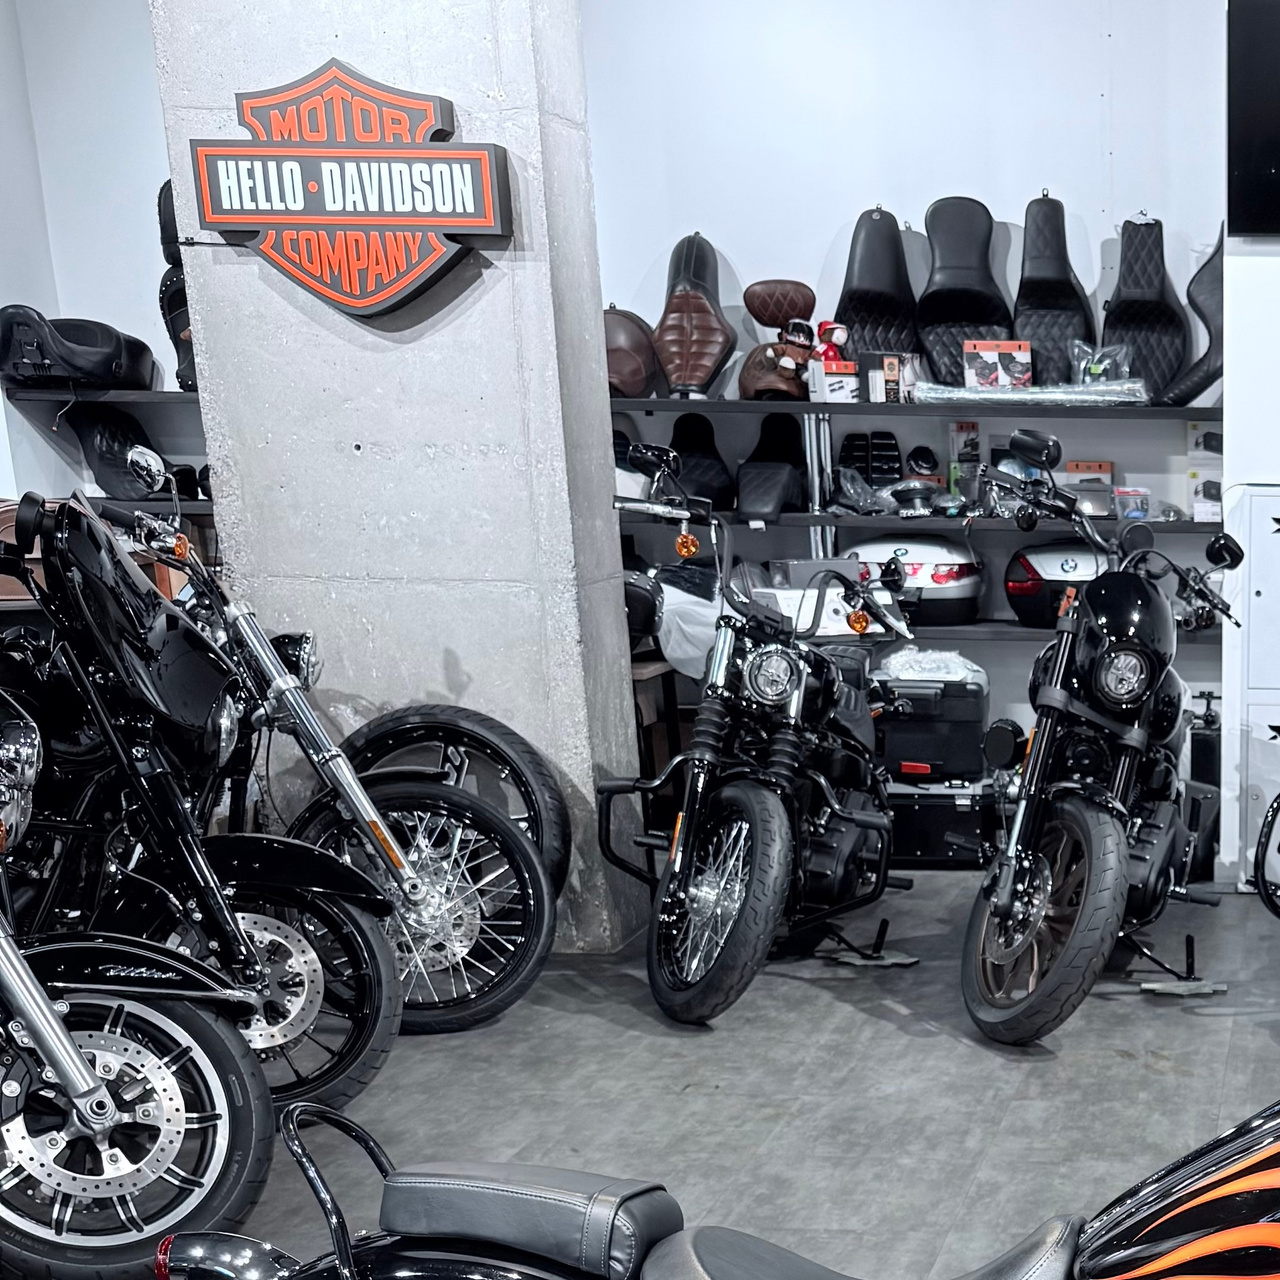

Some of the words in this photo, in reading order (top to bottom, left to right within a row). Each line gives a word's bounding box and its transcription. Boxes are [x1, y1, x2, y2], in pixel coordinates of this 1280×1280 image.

[269, 83, 411, 143] MOTOR
[217, 160, 304, 211] HELLO
[321, 161, 475, 213] DAVIDSON
[281, 230, 422, 295] COMPANY
